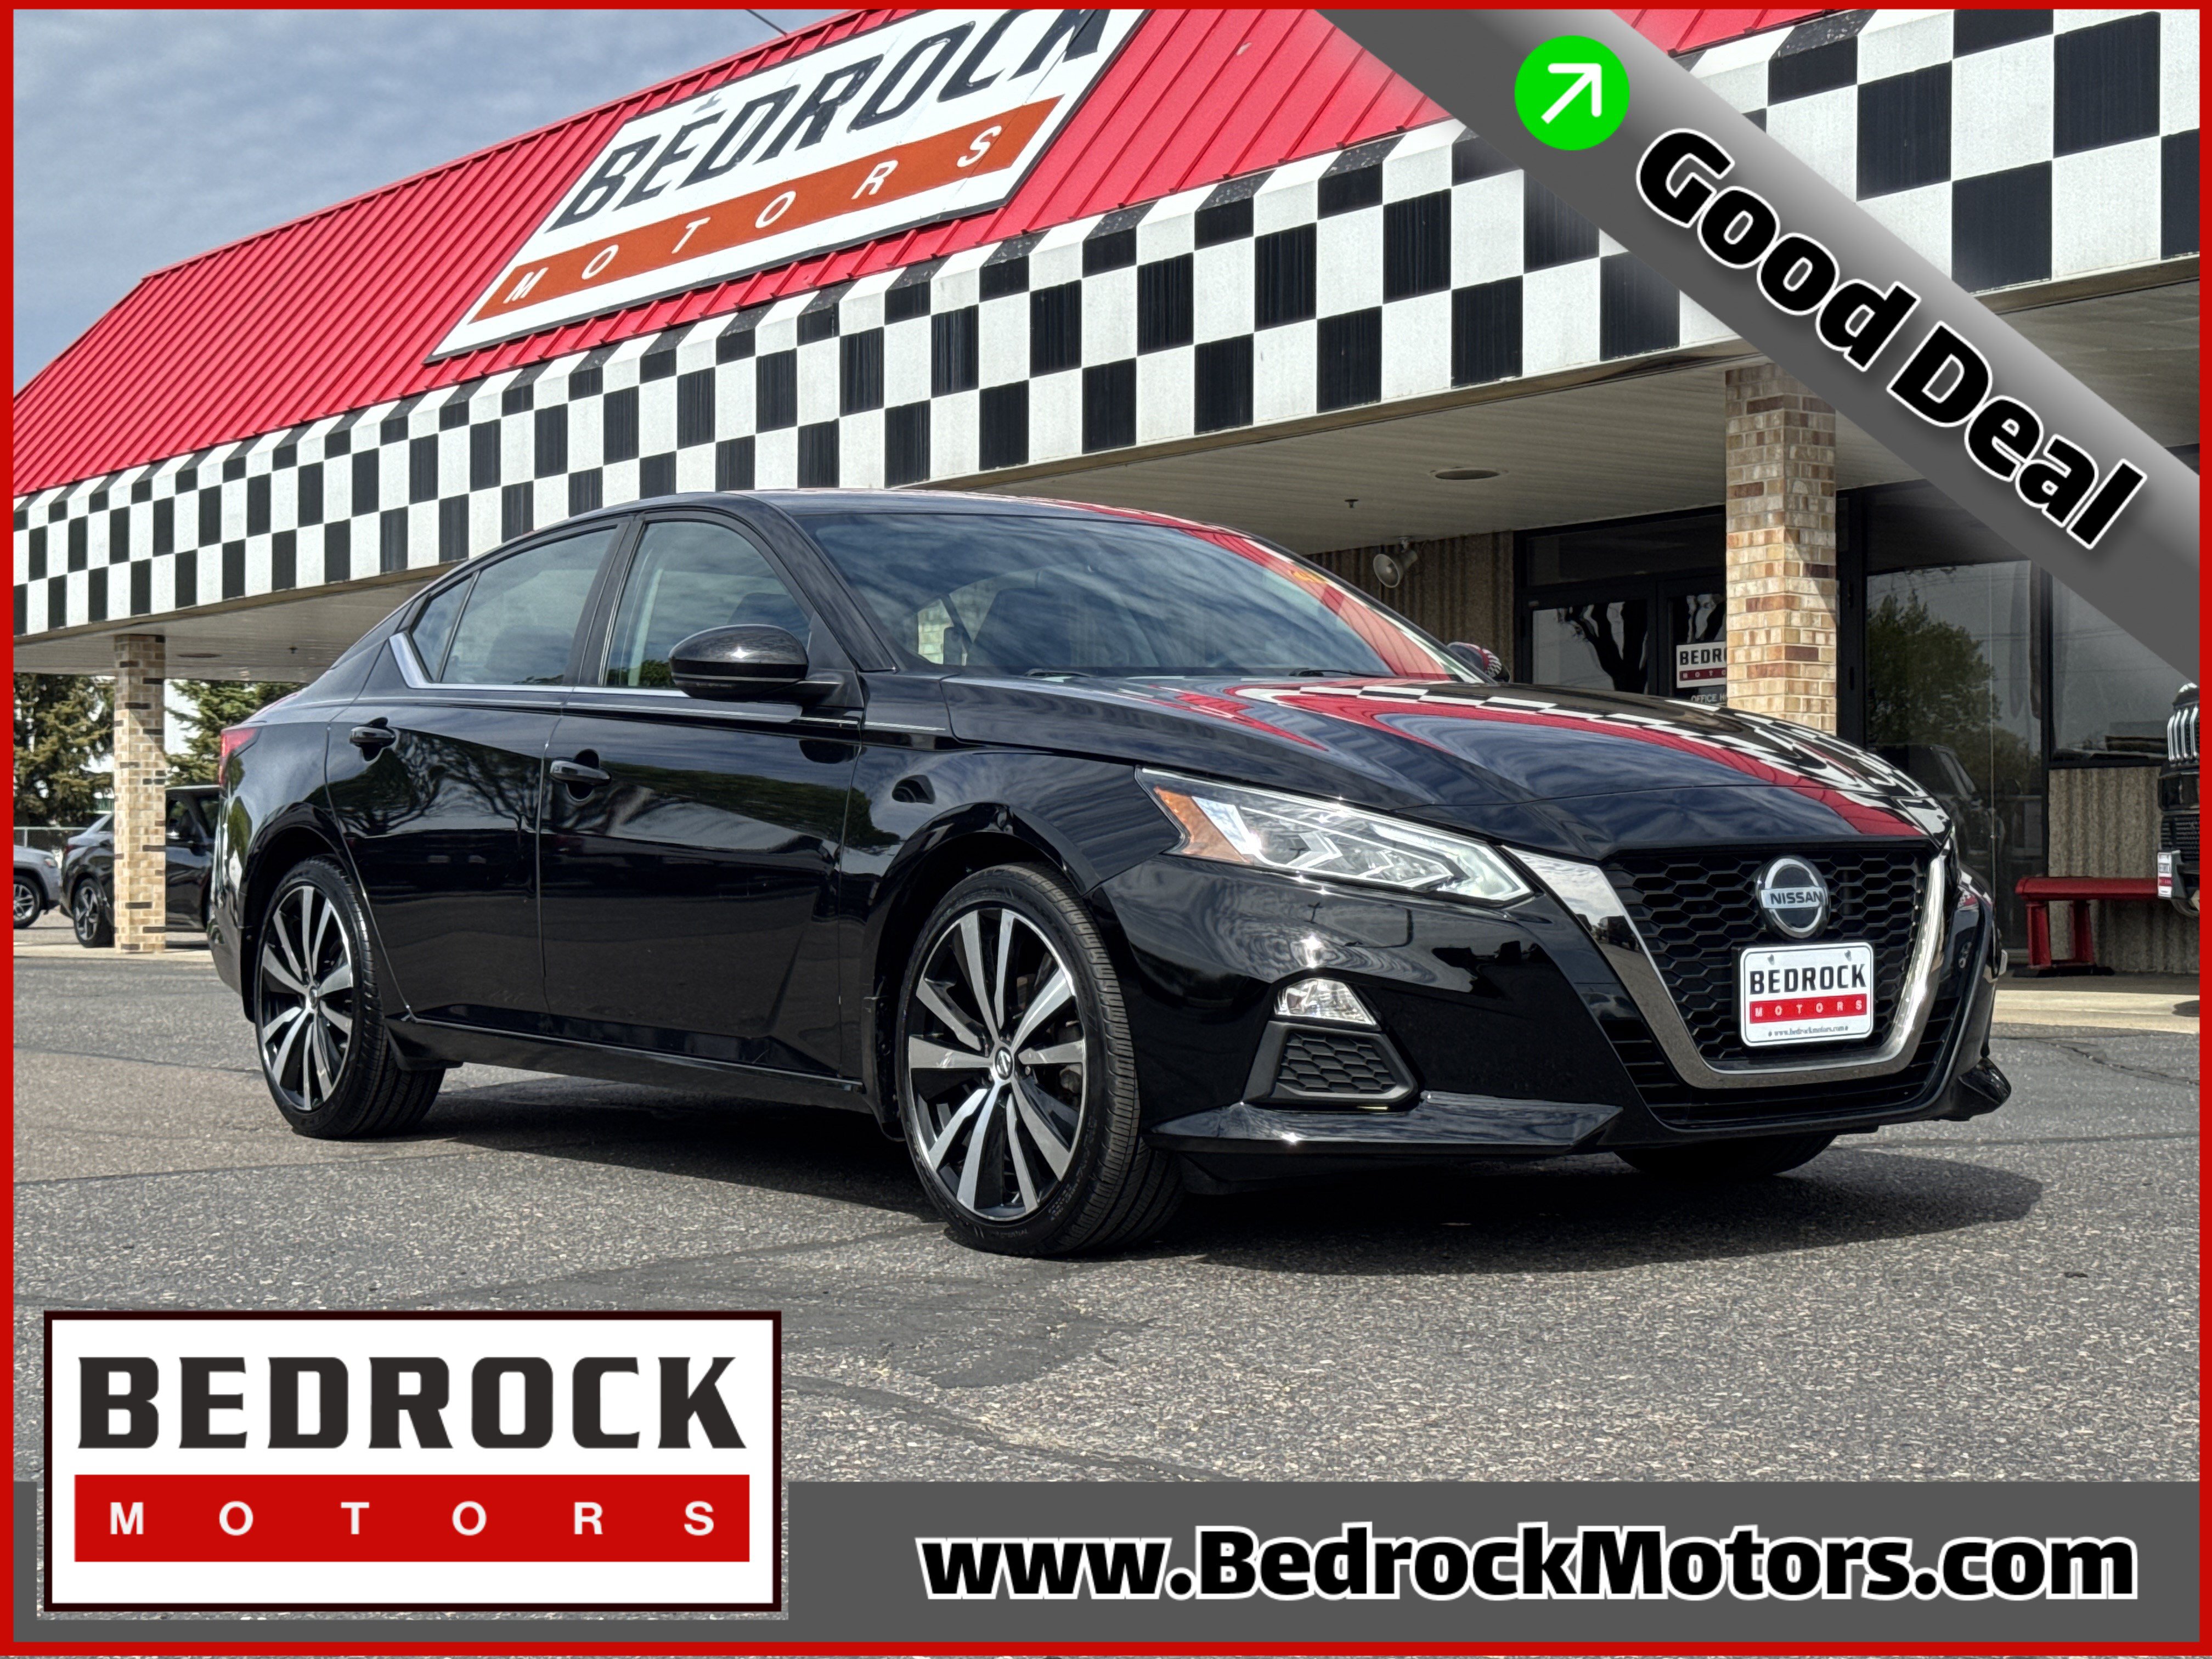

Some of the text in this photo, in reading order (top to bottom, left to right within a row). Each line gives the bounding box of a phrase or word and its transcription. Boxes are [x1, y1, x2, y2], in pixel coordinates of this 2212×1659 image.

[544, 9, 1110, 234] BEDROCK
[503, 126, 1002, 304] MOTORS
[1770, 890, 1824, 905] NISSAN
[1750, 963, 1866, 995] BEDROCK
[1754, 1000, 1863, 1018] MOTORS
